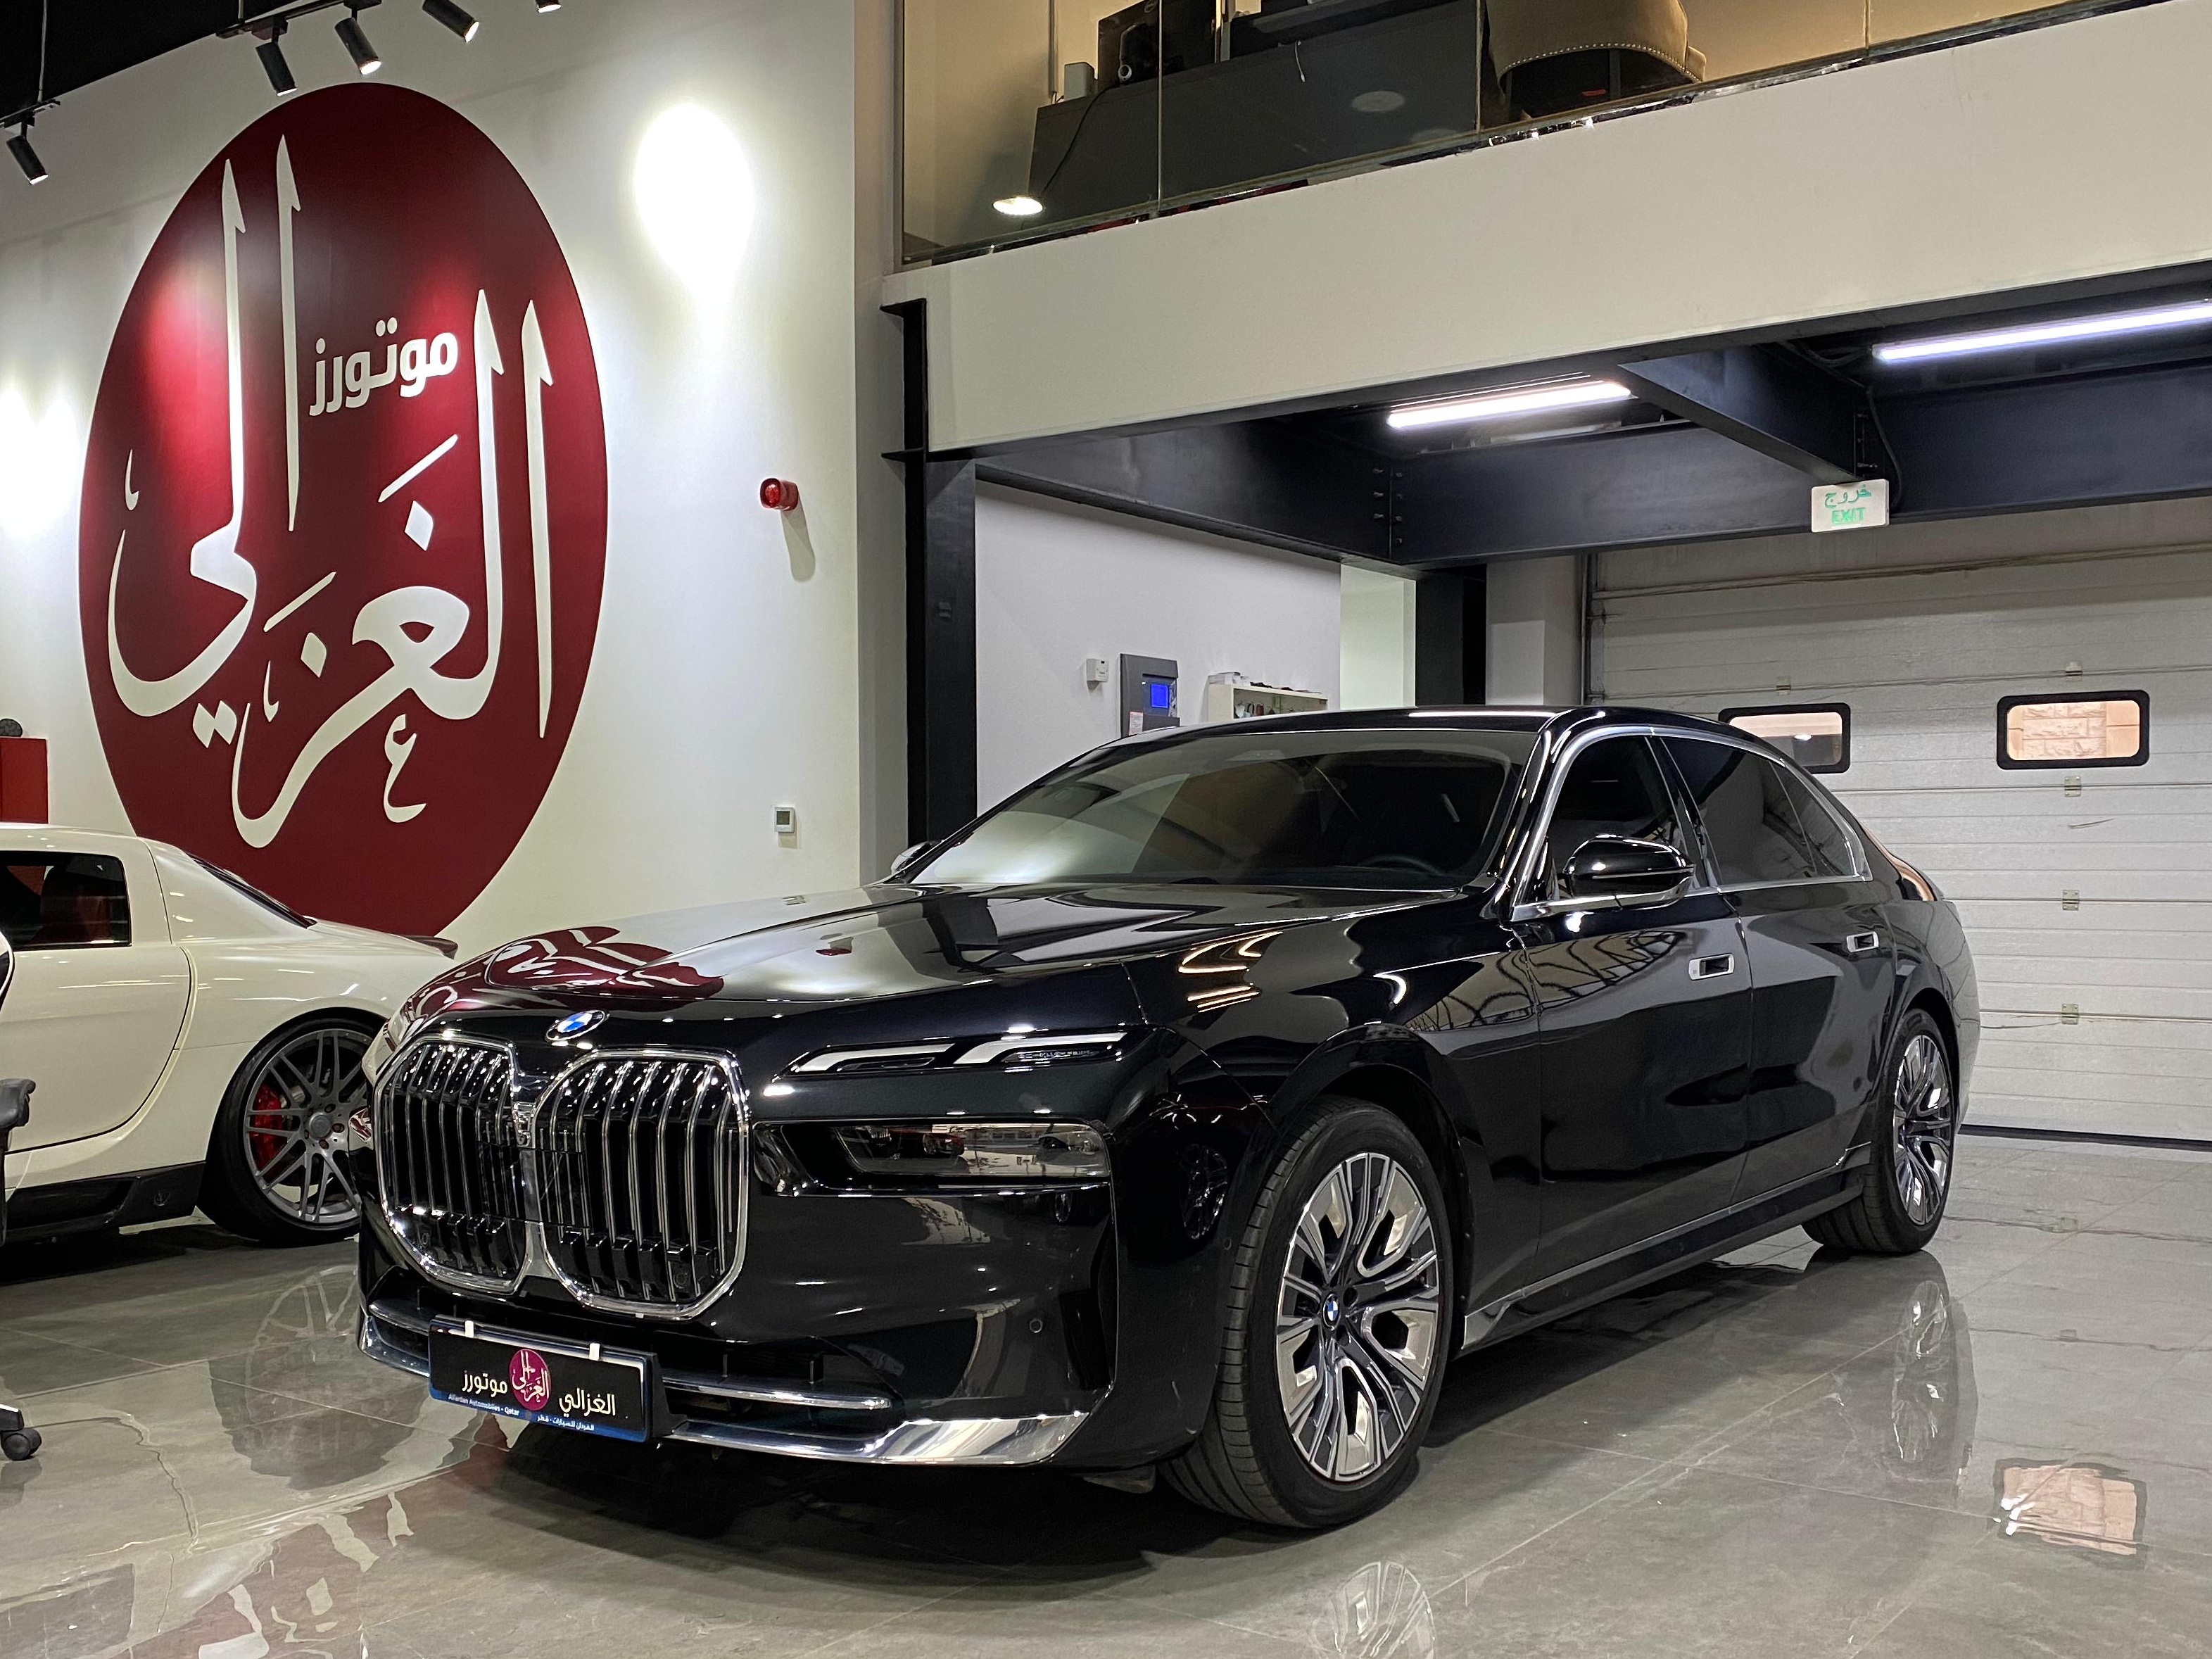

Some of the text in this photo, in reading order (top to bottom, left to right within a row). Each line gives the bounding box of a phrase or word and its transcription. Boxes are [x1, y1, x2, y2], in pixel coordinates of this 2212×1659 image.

[308, 317, 459, 417] موتورز
[1824, 484, 1872, 508] خروج
[1832, 507, 1866, 524] EXIT
[462, 1370, 616, 1418] الغزالي موتورز
[504, 1406, 519, 1415] Qatar
[537, 1414, 549, 1423] قطر
